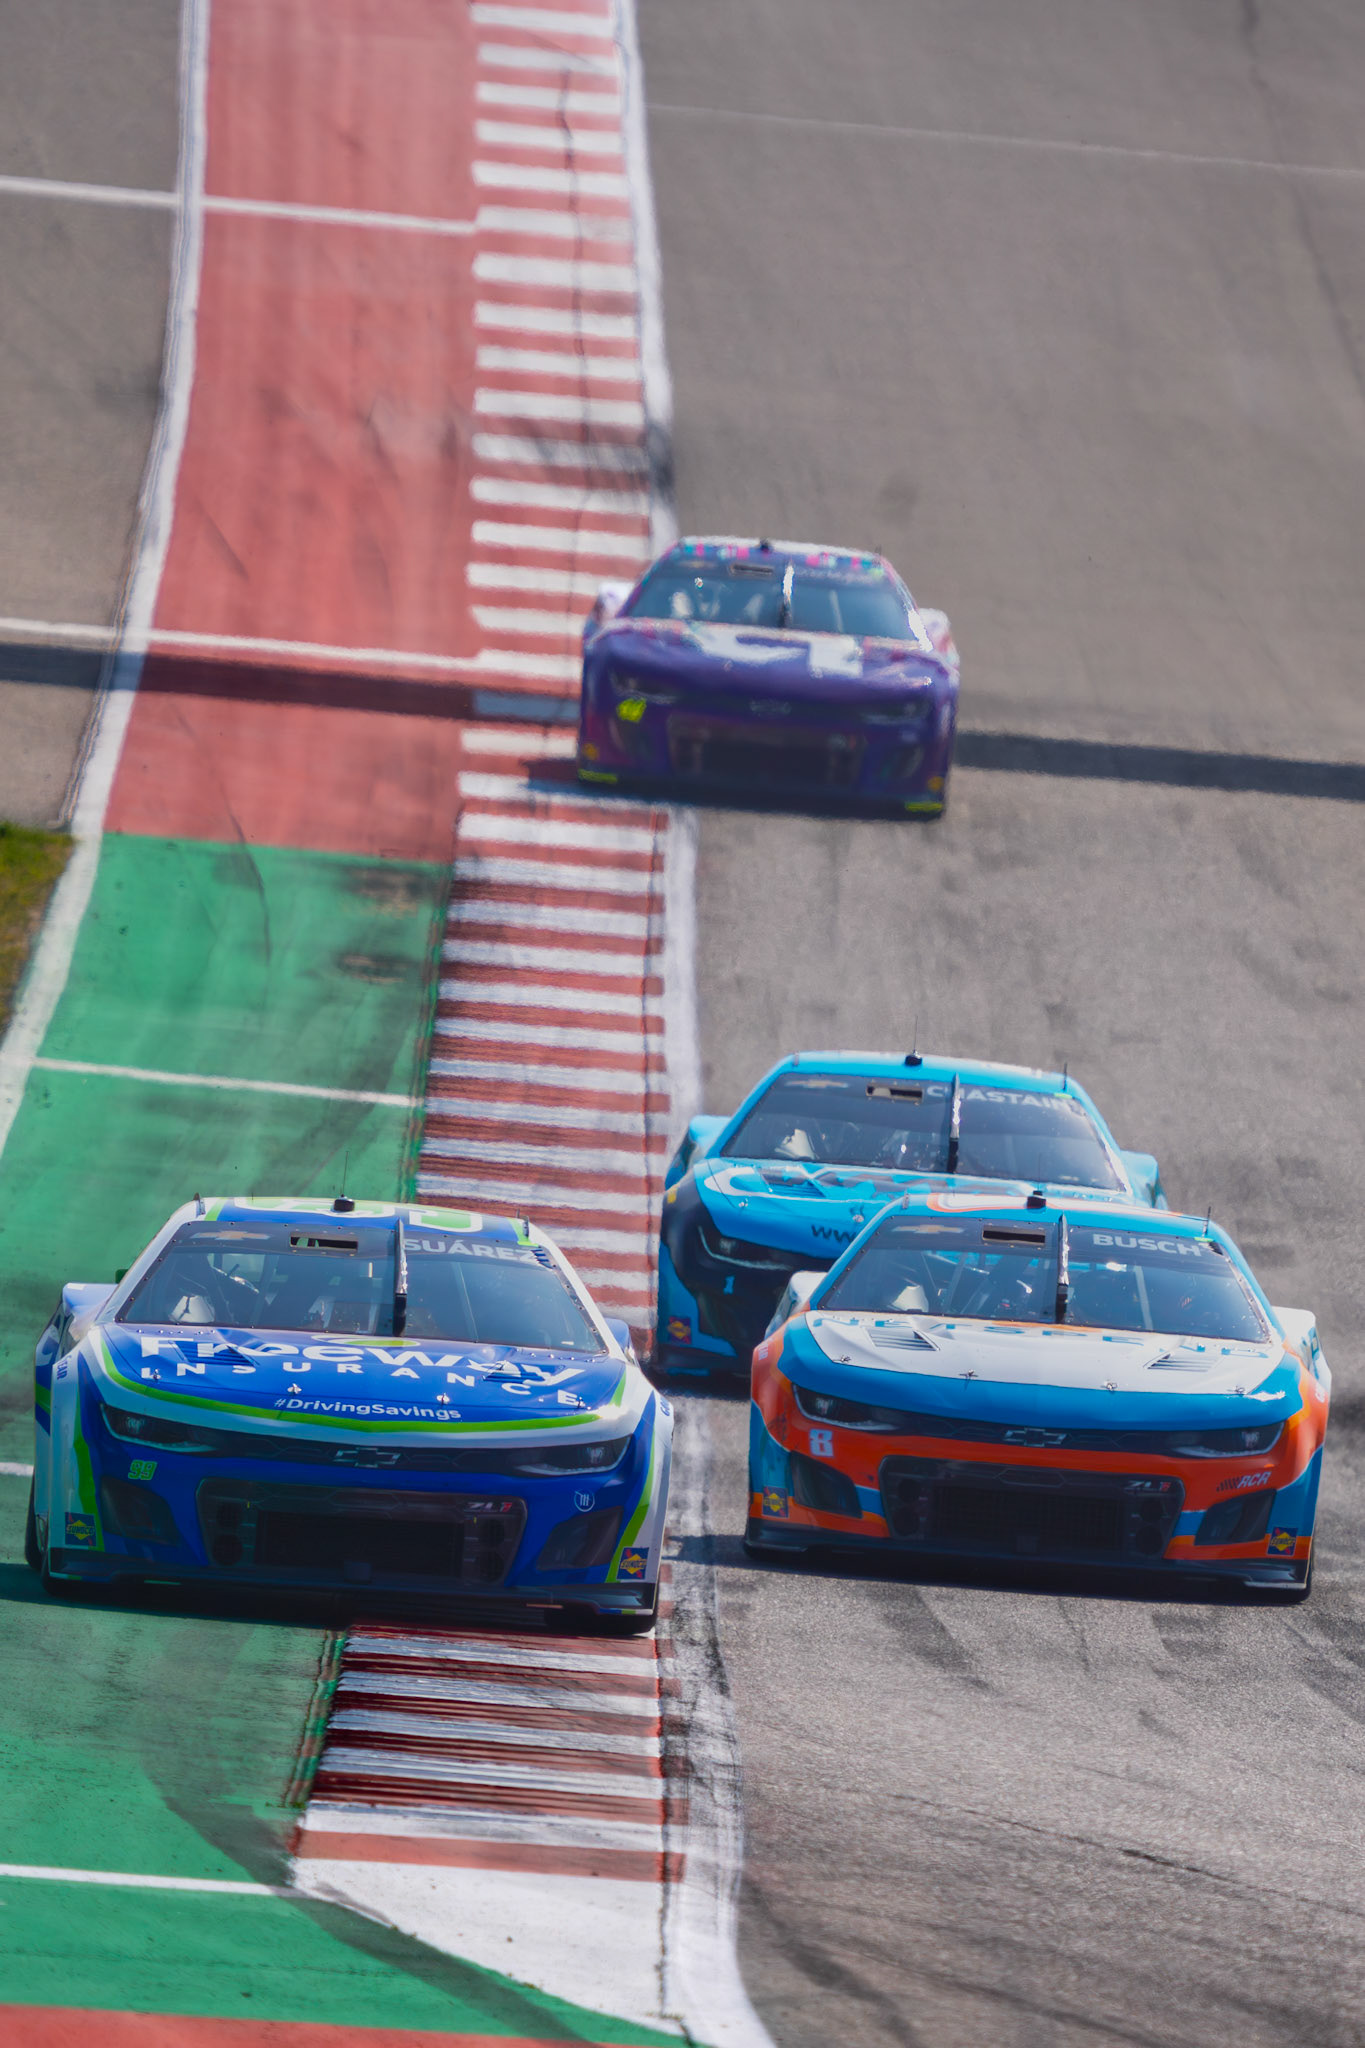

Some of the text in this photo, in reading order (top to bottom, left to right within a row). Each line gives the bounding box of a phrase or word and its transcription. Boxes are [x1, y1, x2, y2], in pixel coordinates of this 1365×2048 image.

[1093, 1233, 1202, 1257] BUSCH
[723, 1275, 735, 1295] 1
[274, 1398, 461, 1420] #DrivingSavings
[808, 1428, 834, 1457] 8
[128, 1459, 158, 1481] 99
